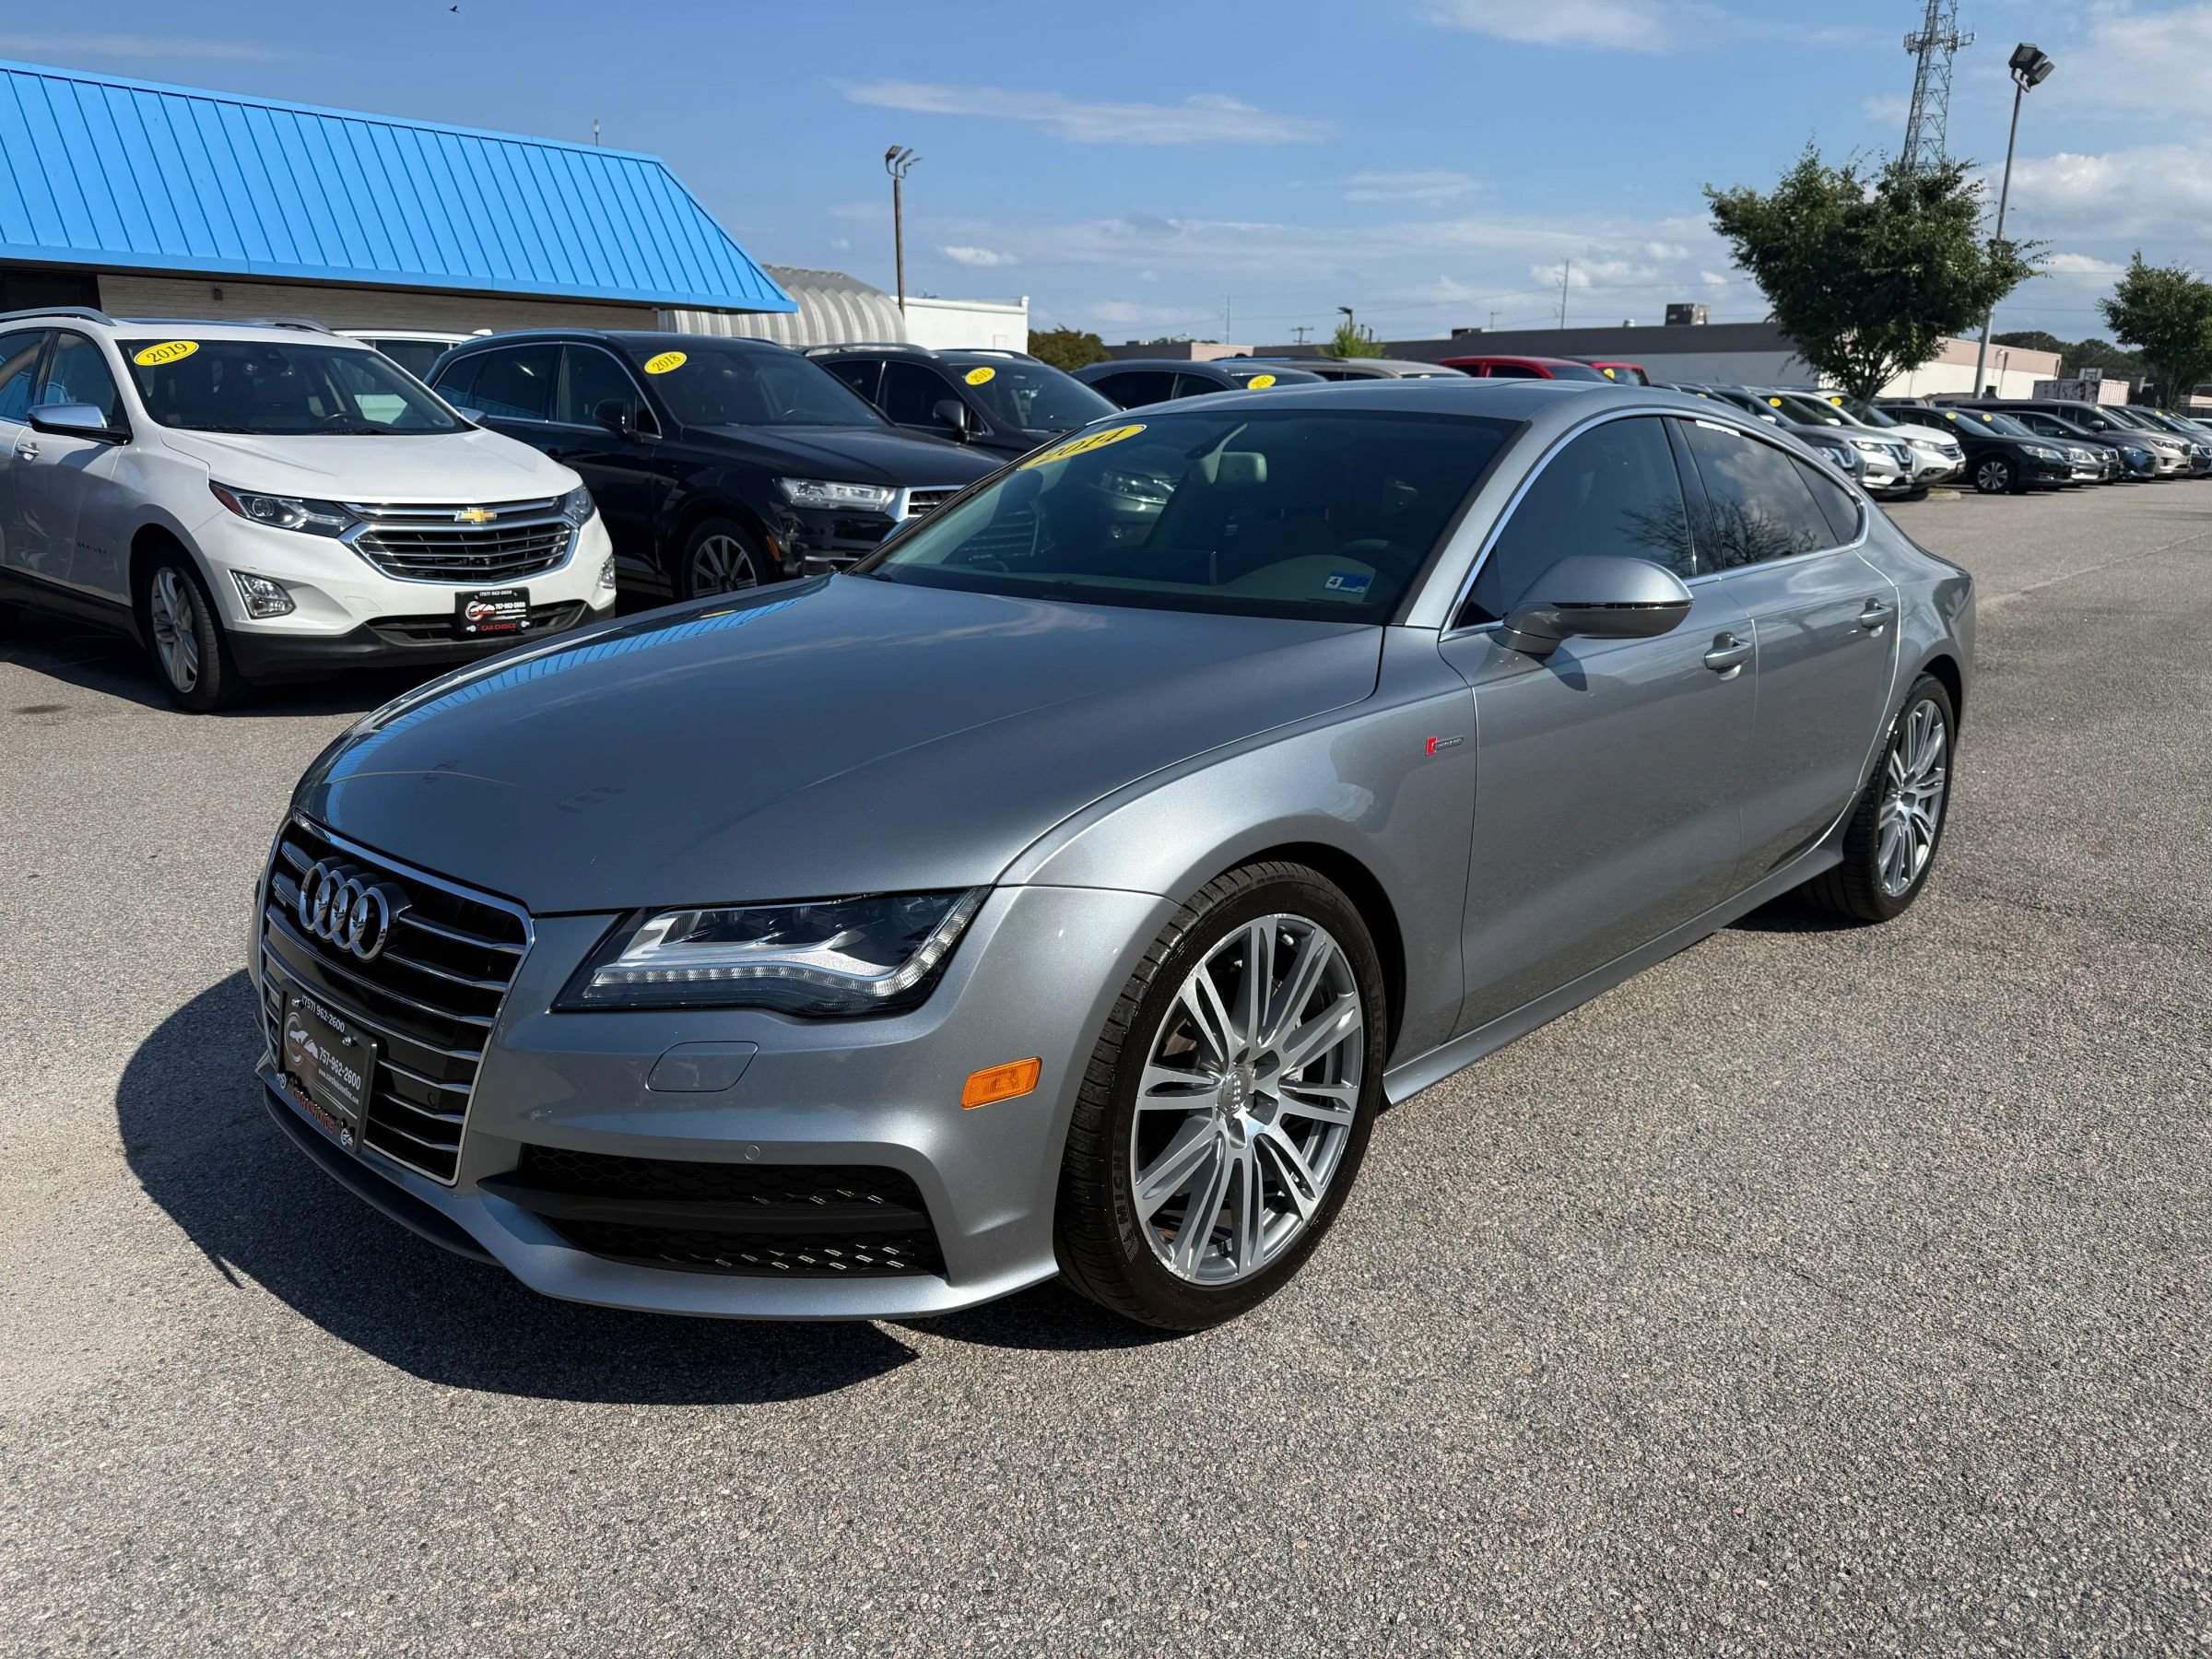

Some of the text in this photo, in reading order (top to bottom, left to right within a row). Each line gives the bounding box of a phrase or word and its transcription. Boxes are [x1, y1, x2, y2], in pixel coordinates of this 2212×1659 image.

[147, 342, 188, 362] 2019
[653, 353, 680, 371] 2018
[1033, 428, 1129, 465] 2014
[1329, 578, 1339, 586] 4
[301, 994, 346, 1033] (757) 962-2600
[319, 1047, 361, 1091] 757-962-2600
